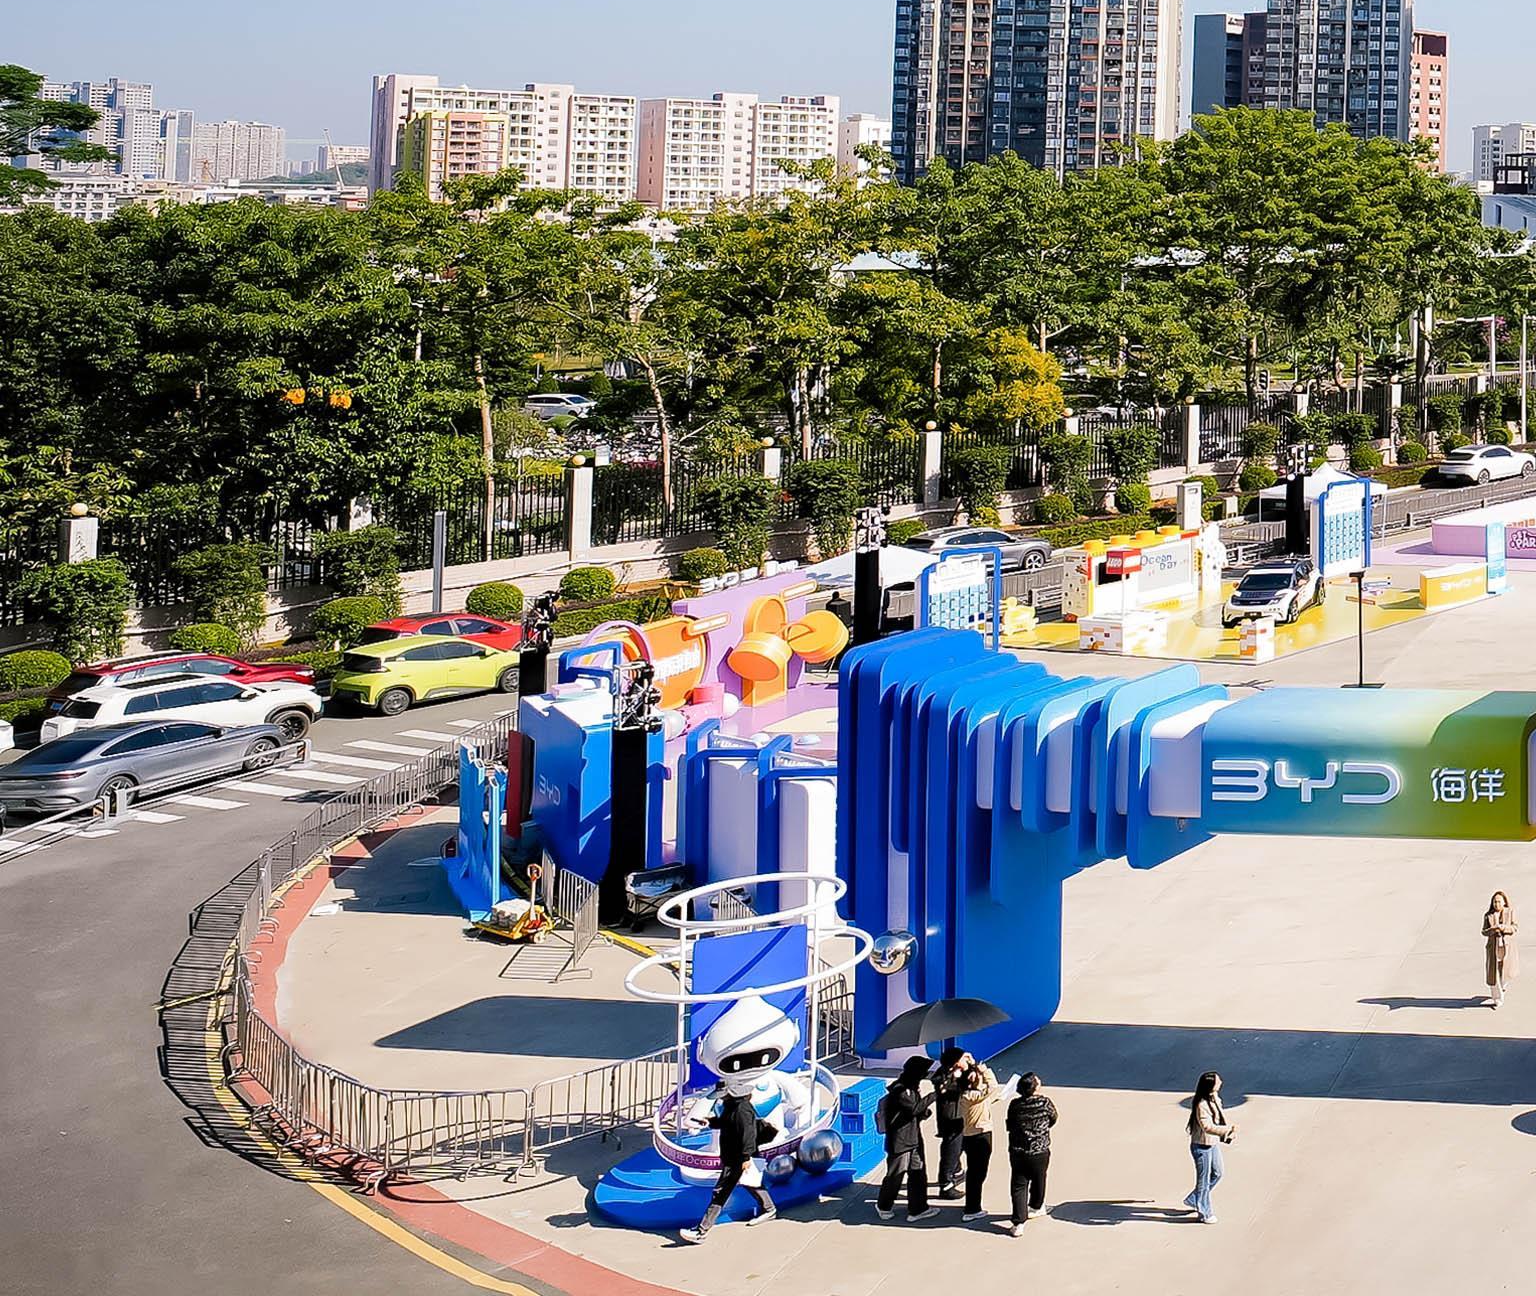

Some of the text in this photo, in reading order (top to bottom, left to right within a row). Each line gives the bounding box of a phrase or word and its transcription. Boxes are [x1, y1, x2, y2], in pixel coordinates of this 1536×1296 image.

[539, 773, 561, 806] BYD
[1211, 759, 1505, 804] BYD 海洋
